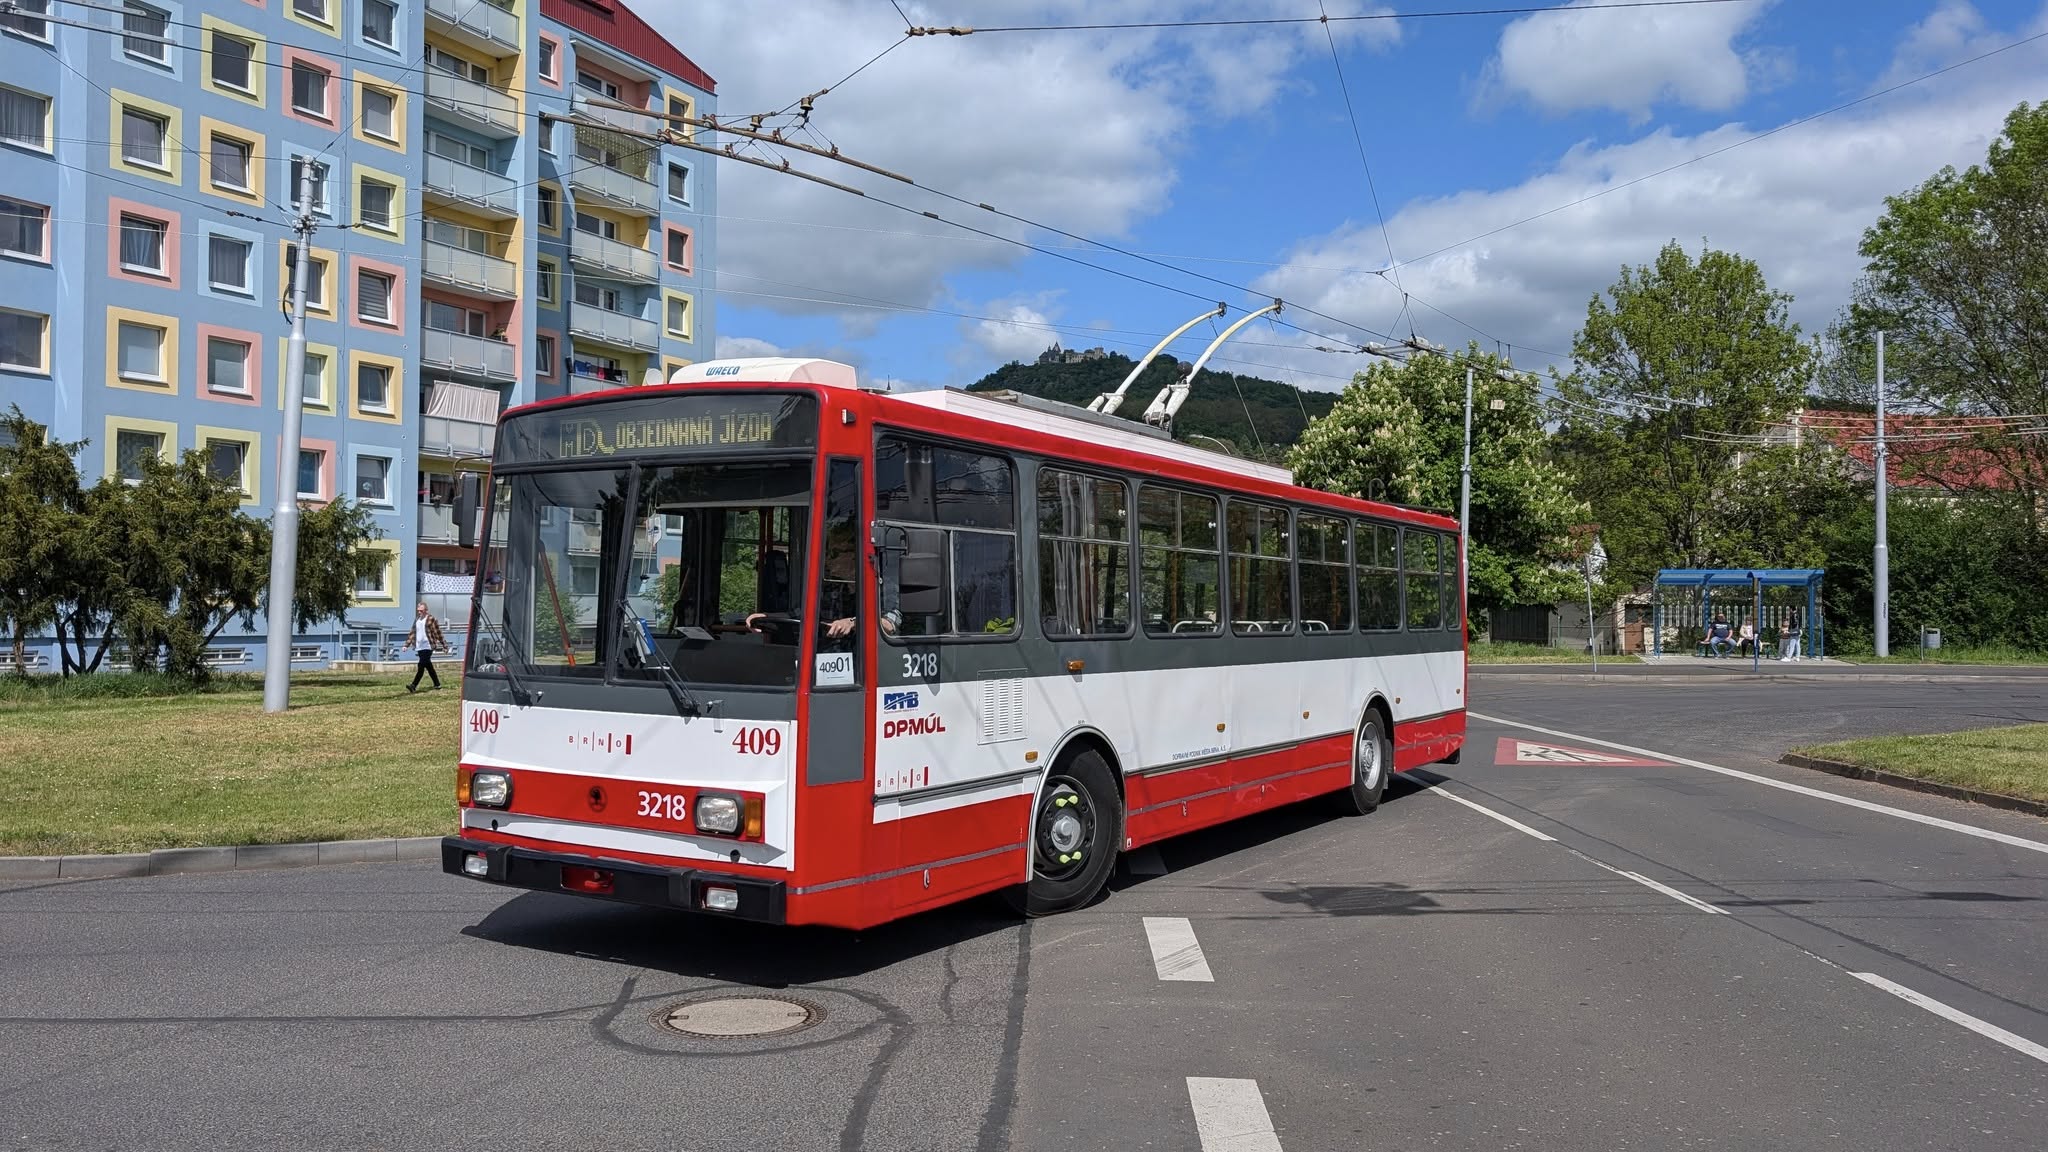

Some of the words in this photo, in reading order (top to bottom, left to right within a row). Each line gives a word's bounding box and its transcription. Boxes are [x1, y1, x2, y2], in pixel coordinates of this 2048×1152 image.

[705, 366, 741, 377] WAECO
[616, 410, 713, 449] OBJEDNANÁ
[720, 408, 772, 444] JÍZDA
[902, 653, 938, 678] 3218
[469, 708, 499, 734] 409
[883, 712, 946, 739] DPMÚL
[732, 727, 781, 756] 409
[637, 791, 687, 821] 3218
